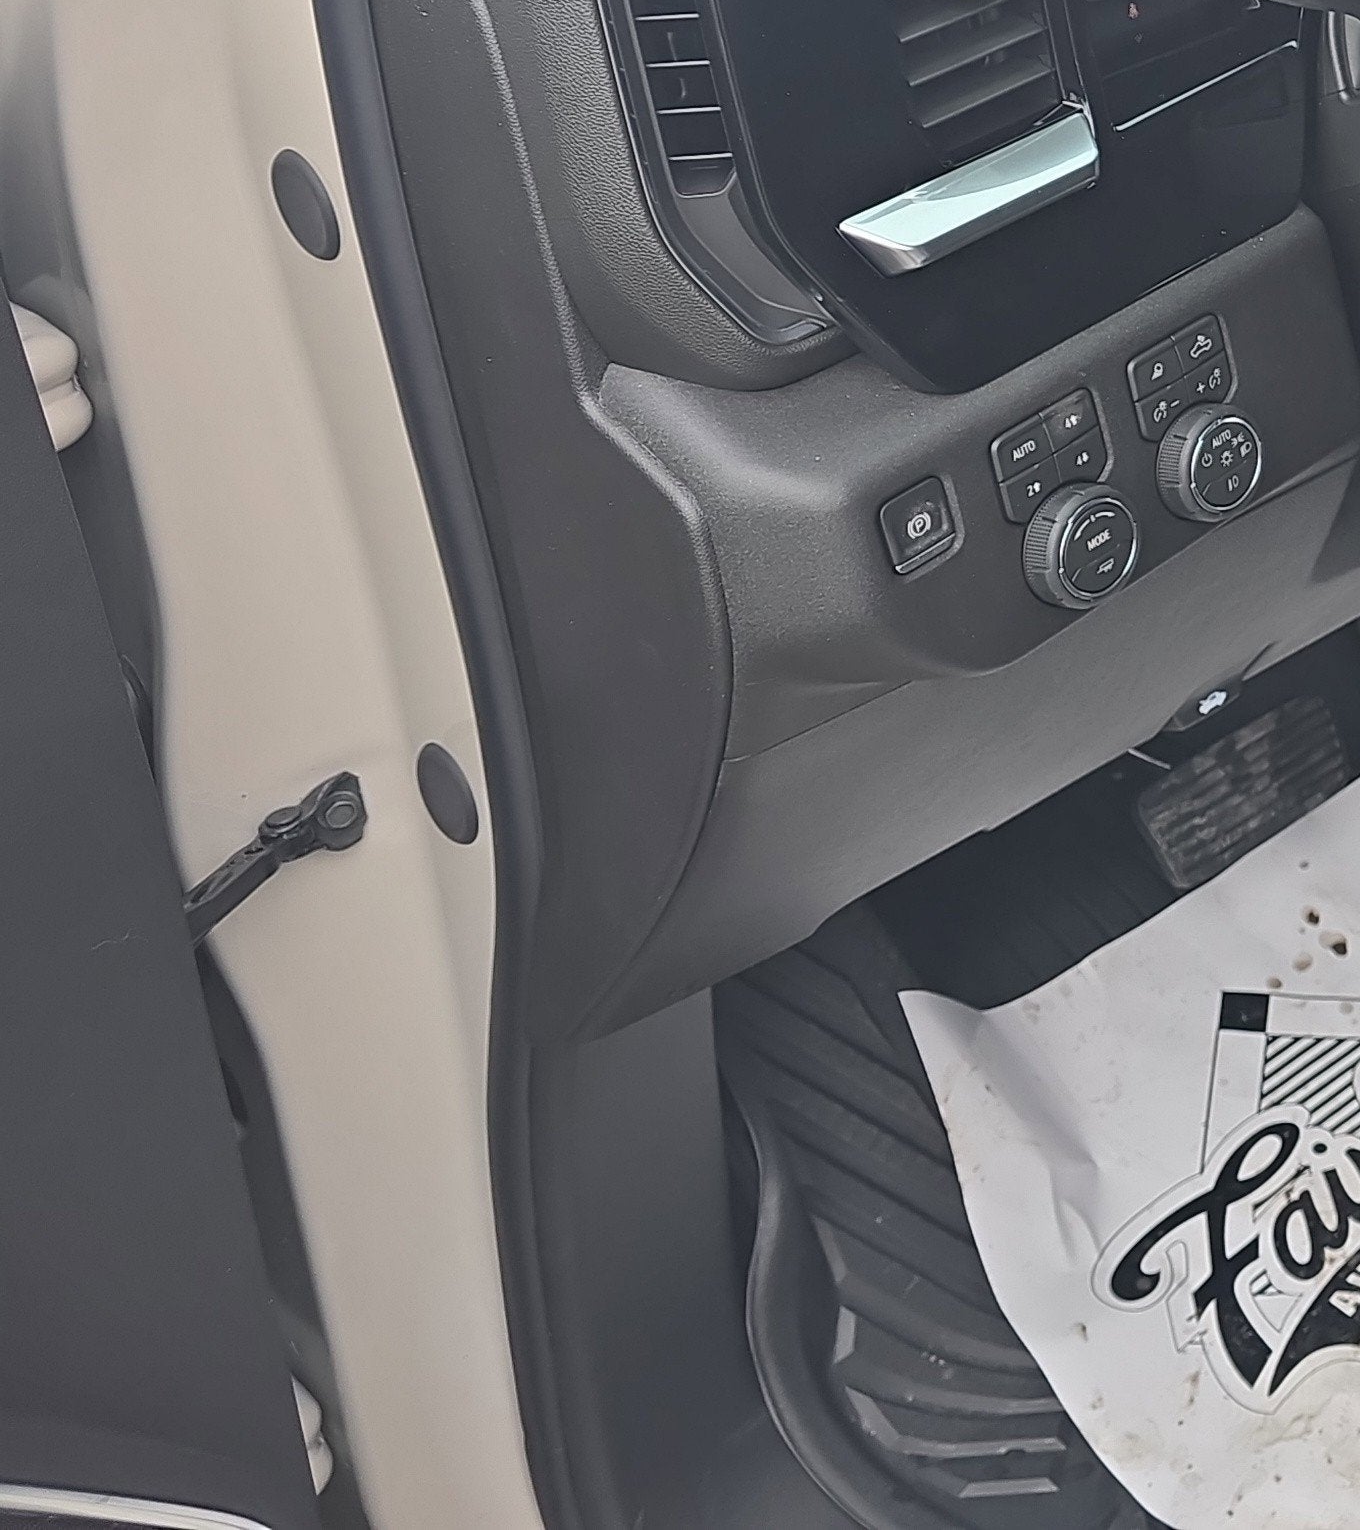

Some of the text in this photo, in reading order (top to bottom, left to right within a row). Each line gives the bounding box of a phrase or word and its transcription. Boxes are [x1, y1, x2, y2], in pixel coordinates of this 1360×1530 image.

[1012, 439, 1037, 462] AUTO
[1211, 428, 1232, 450] AUTO
[1086, 529, 1113, 552] MODE
